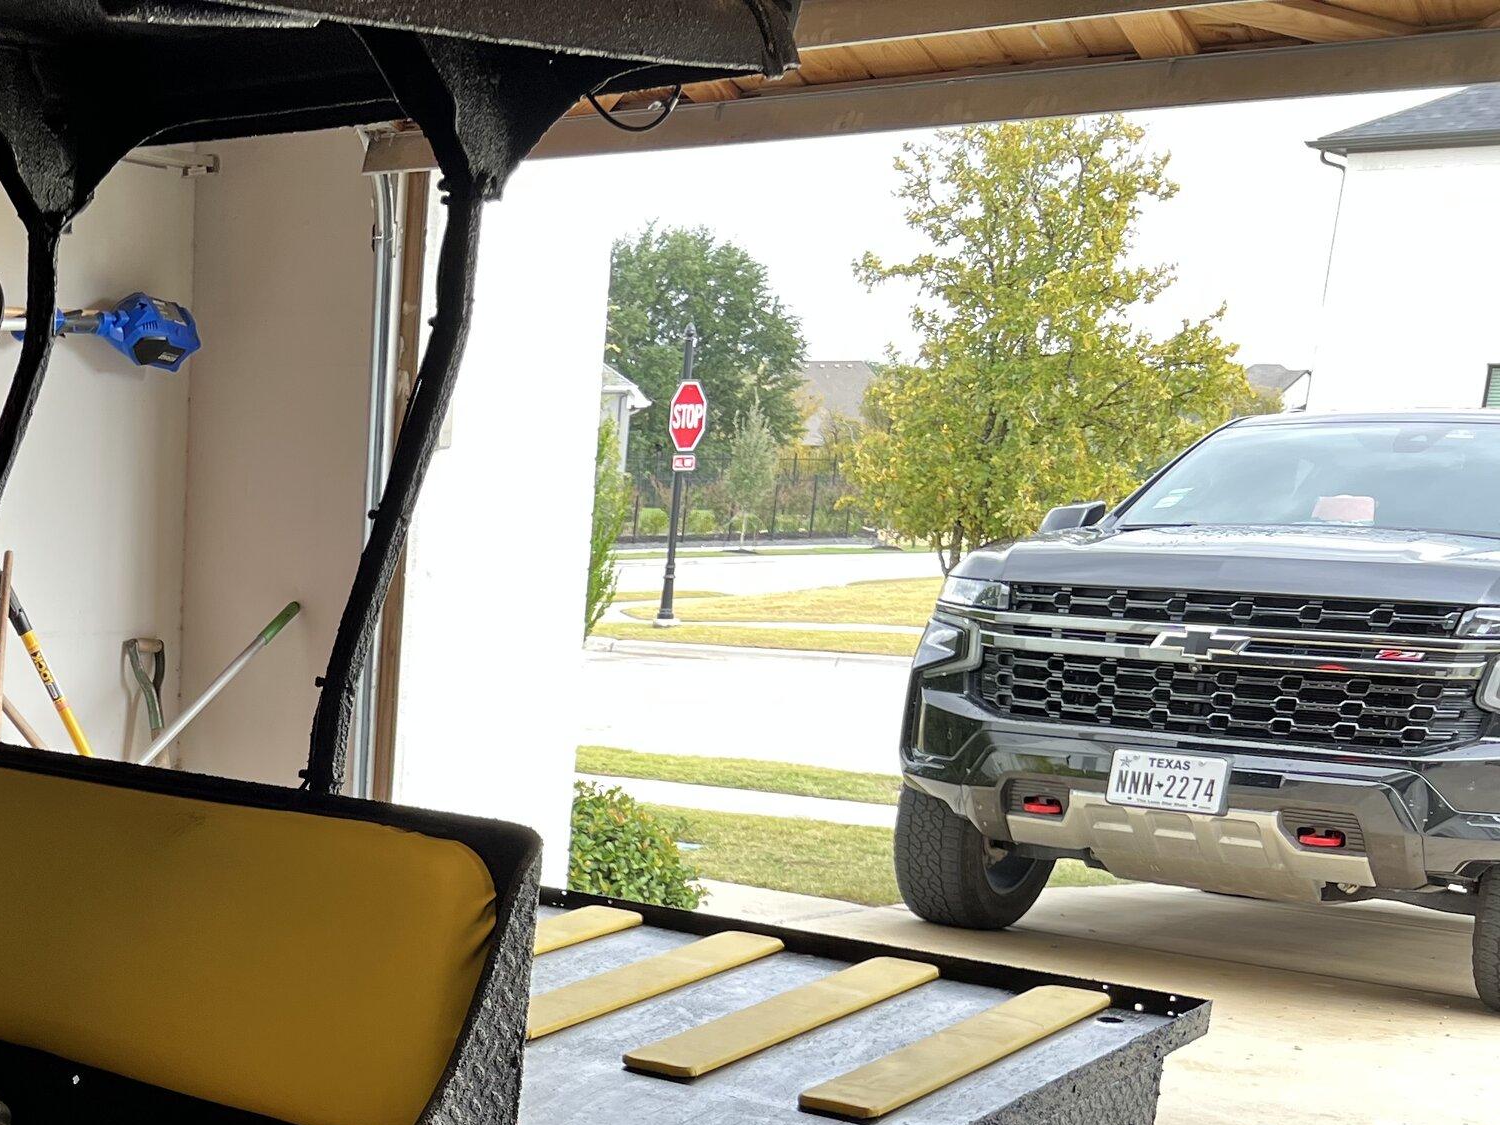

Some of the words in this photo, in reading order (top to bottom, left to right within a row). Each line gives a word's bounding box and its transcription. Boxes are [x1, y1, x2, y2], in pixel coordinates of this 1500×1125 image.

[672, 403, 703, 430] STOP
[1148, 758, 1191, 770] TEXAS
[1115, 769, 1155, 796] NNN
[1163, 775, 1215, 802] 2274
